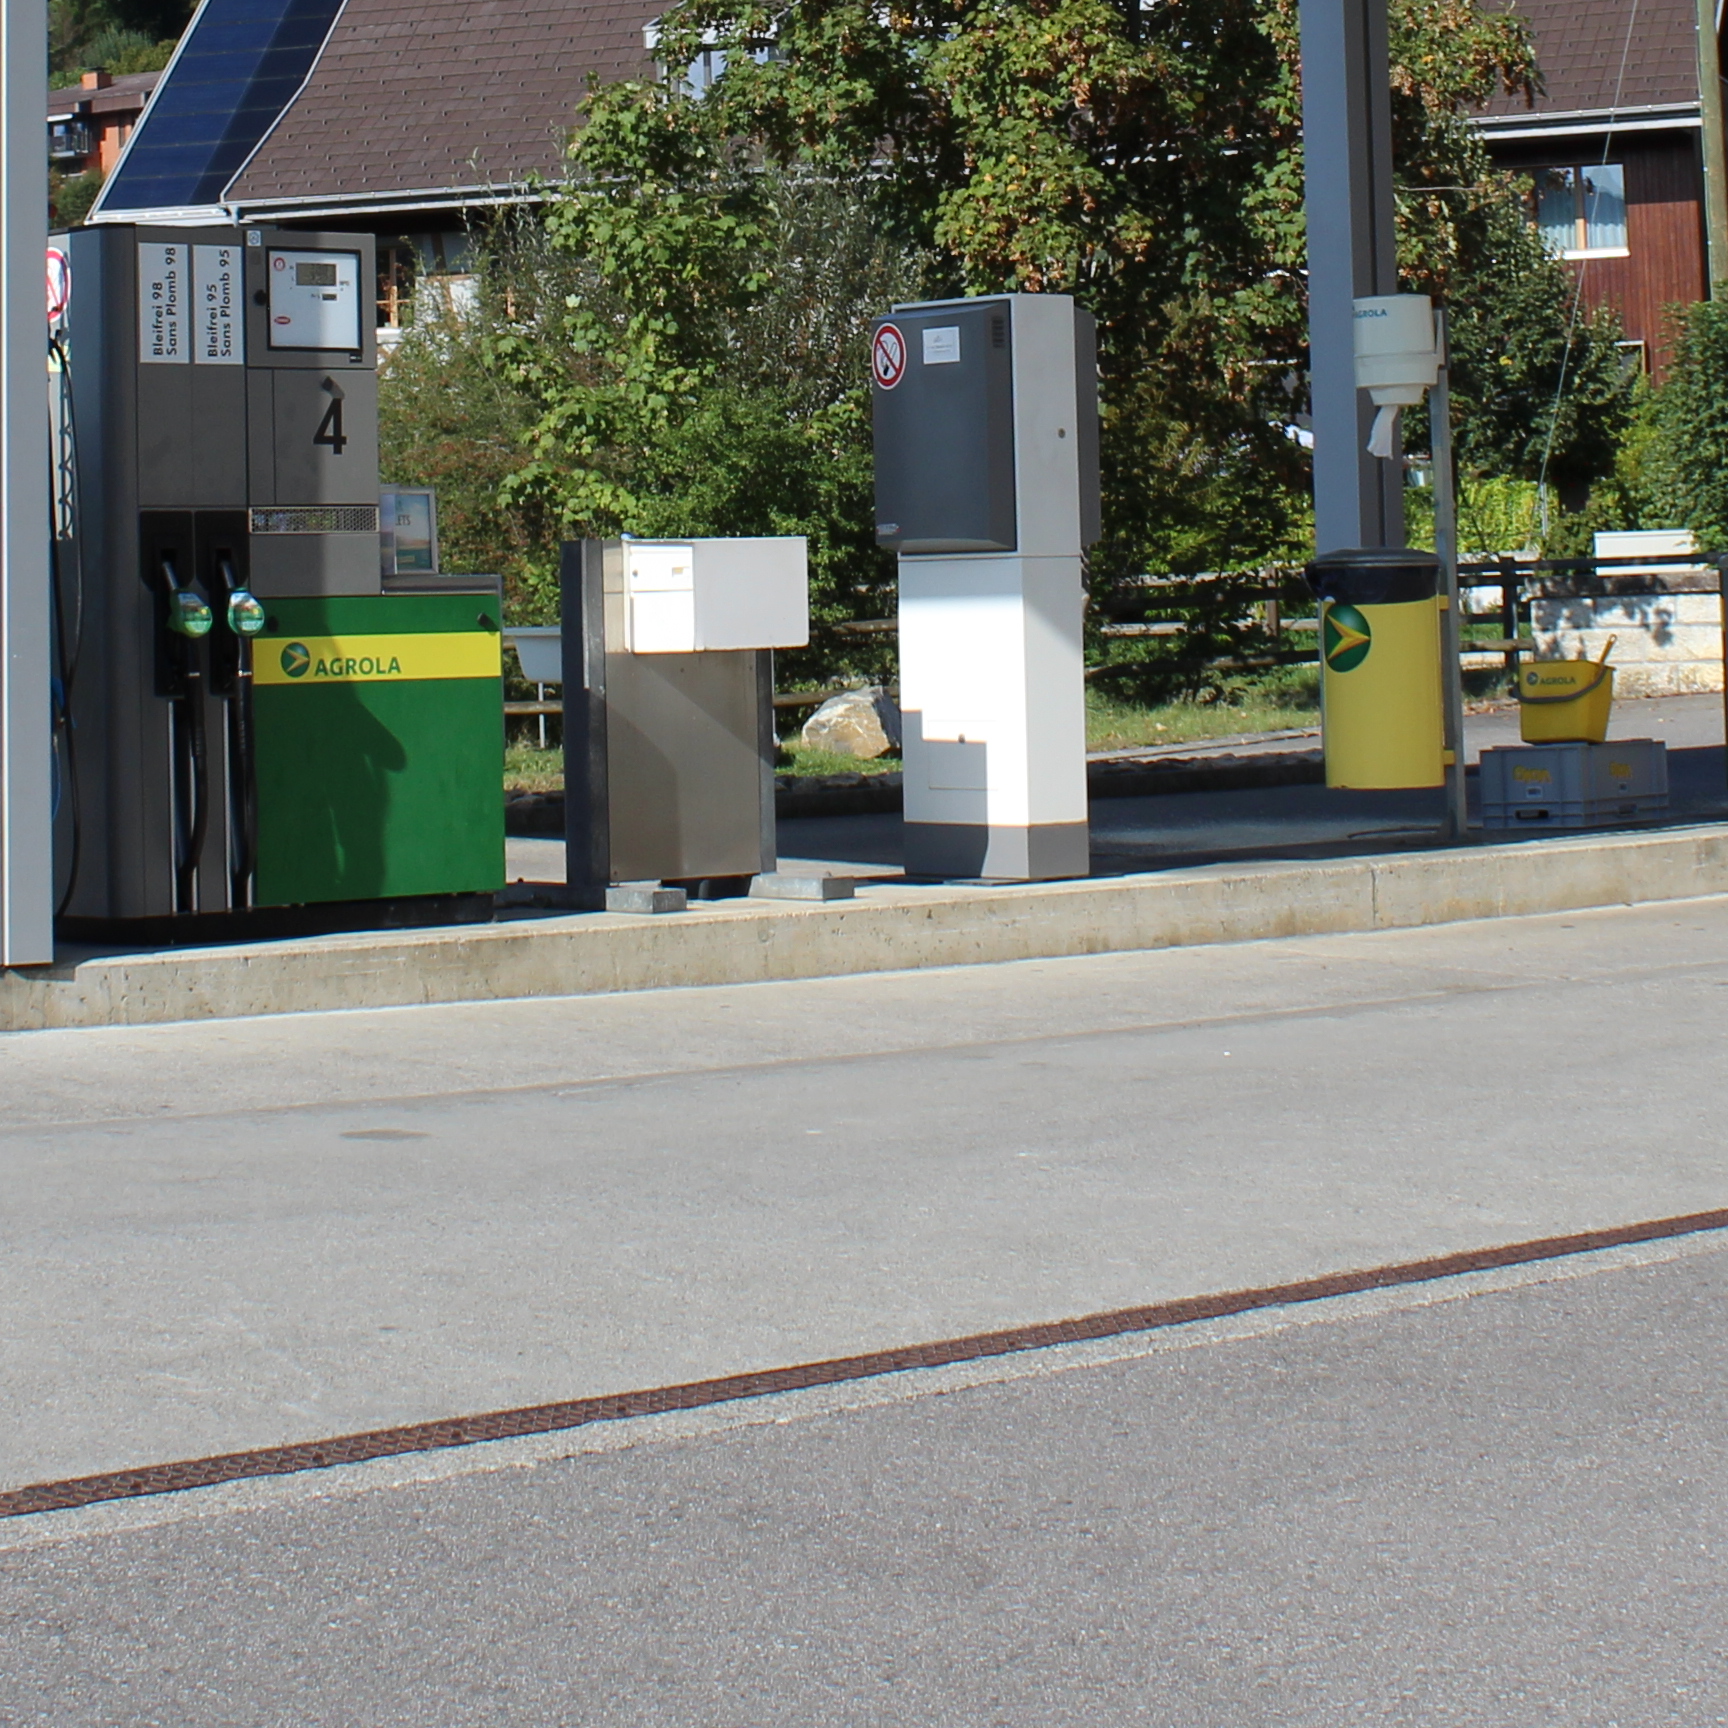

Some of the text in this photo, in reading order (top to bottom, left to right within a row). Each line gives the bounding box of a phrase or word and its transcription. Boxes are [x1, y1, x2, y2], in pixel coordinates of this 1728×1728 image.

[152, 281, 163, 356] Bleifrei 98
[165, 247, 177, 356] Sans Plomb 98
[206, 284, 218, 357] Bleifrei 95
[219, 249, 232, 357] Sans Plomb 95
[313, 397, 348, 455] 4
[314, 656, 401, 677] AGROLA
[1539, 675, 1577, 686] AGROLA
